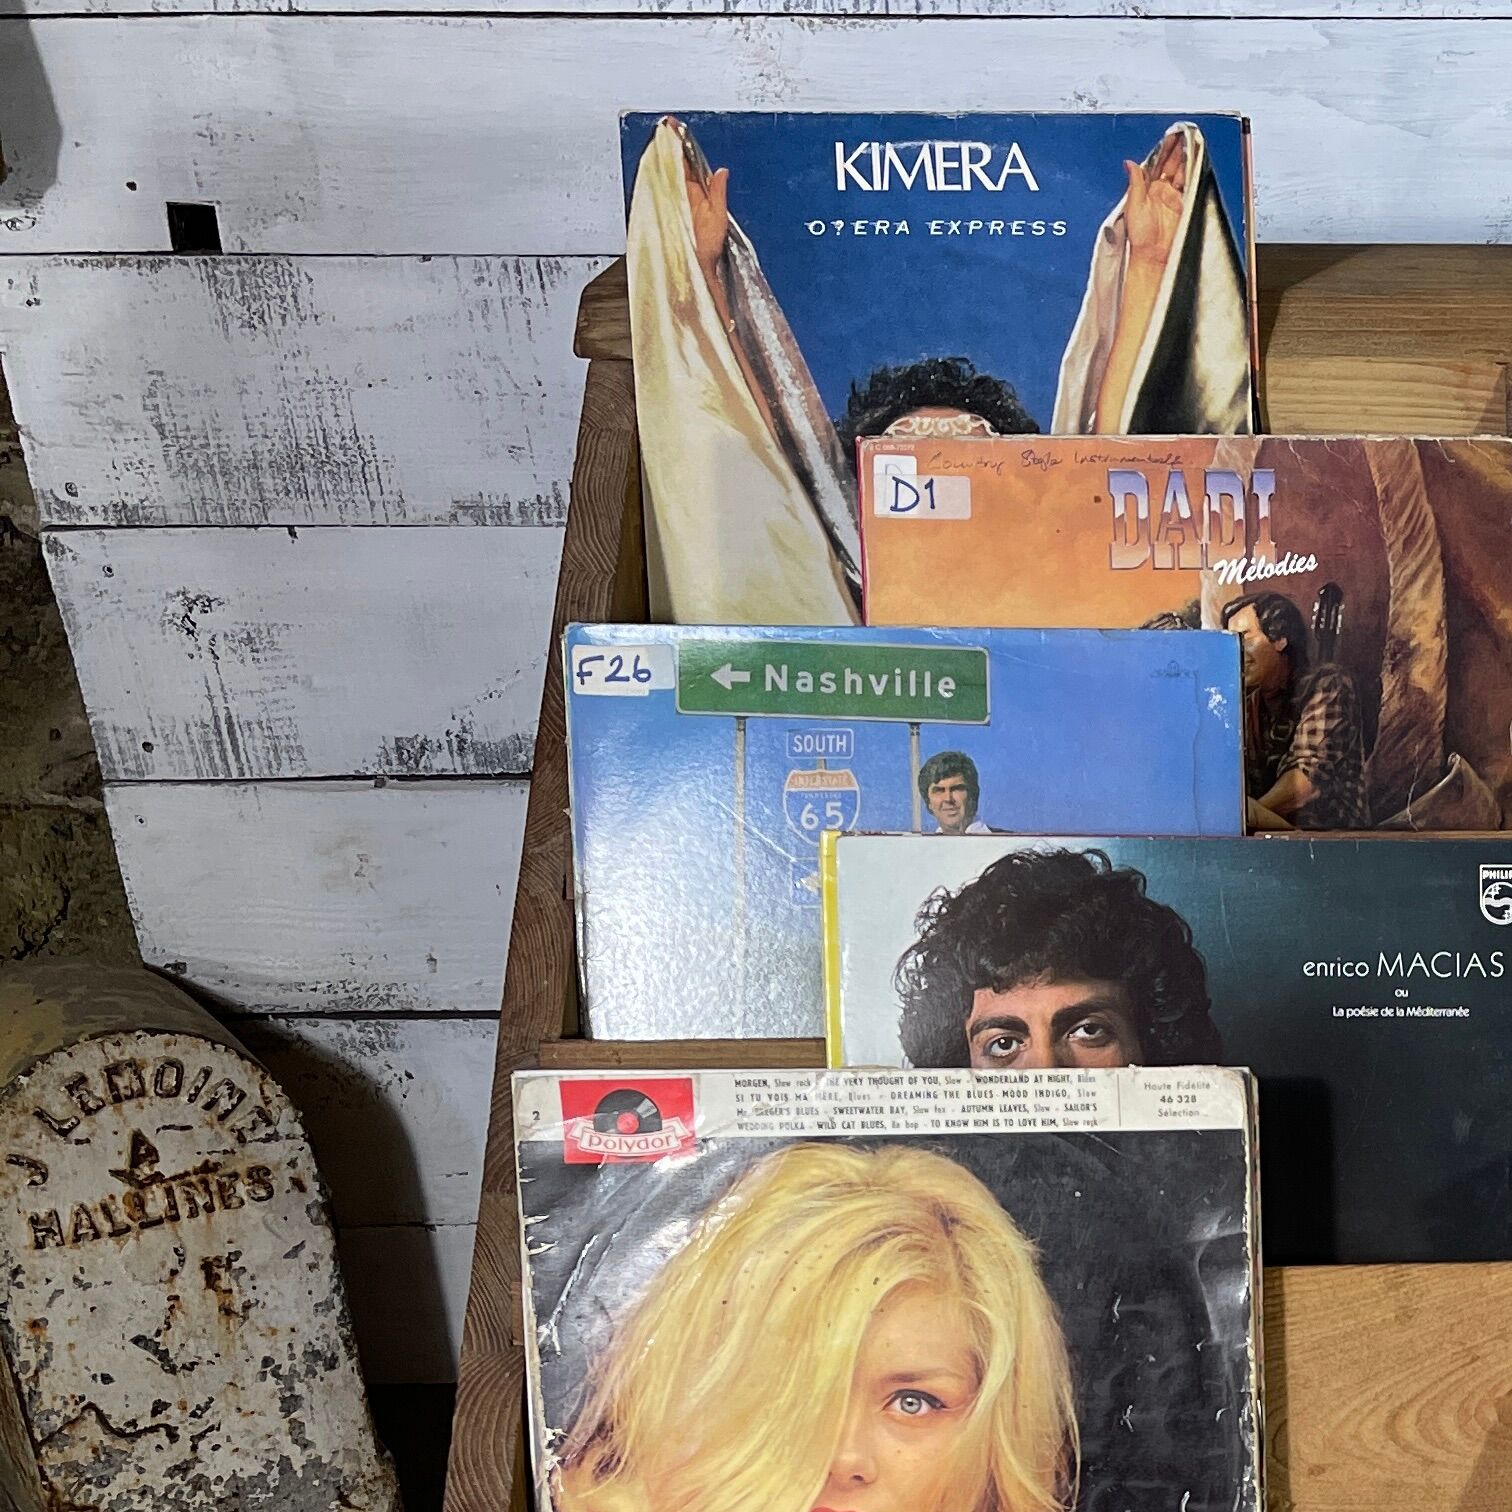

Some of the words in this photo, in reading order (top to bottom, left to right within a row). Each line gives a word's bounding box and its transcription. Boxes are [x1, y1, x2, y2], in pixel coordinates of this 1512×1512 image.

[835, 142, 1039, 191] KIMERA
[927, 220, 1067, 236] EXPRESS
[890, 476, 936, 512] D1
[1107, 468, 1277, 569] DADI
[1213, 552, 1319, 586] Mélodies
[577, 654, 651, 685] F26
[765, 664, 956, 697] Nashville
[793, 734, 847, 752] SOUTH
[801, 802, 844, 831] 65
[1303, 957, 1370, 977] enrico
[1377, 951, 1505, 978] MACIAS
[1395, 988, 1409, 998] ou
[1332, 1006, 1345, 1017] La
[1346, 1006, 1379, 1019] poésie
[1380, 1006, 1394, 1017] de
[1395, 1006, 1404, 1017] la
[844, 1077, 863, 1086] VERY
[867, 1076, 904, 1086] THOUGHT
[908, 1076, 918, 1085] OF
[975, 1074, 1029, 1084] WONDERLAND
[1033, 1074, 1043, 1083] AT
[1144, 1082, 1172, 1091] Haute
[891, 1091, 938, 1100] DREAMING
[944, 1090, 960, 1099] THE
[967, 1090, 994, 1099] BLUES
[1002, 1089, 1028, 1098] MOOD
[1160, 1095, 1174, 1104] 46
[1177, 1094, 1197, 1104] 328
[532, 1111, 541, 1121] 2
[833, 1106, 885, 1115] SWEETWATER
[961, 1104, 994, 1113] AUTUMN
[817, 1120, 837, 1130] WILD
[841, 1120, 855, 1129] CAT
[931, 1119, 940, 1128] TO
[945, 1119, 969, 1128] KNOW
[993, 1118, 1000, 1126] IS
[1004, 1118, 1014, 1126] TO
[1018, 1118, 1037, 1126] LOVE
